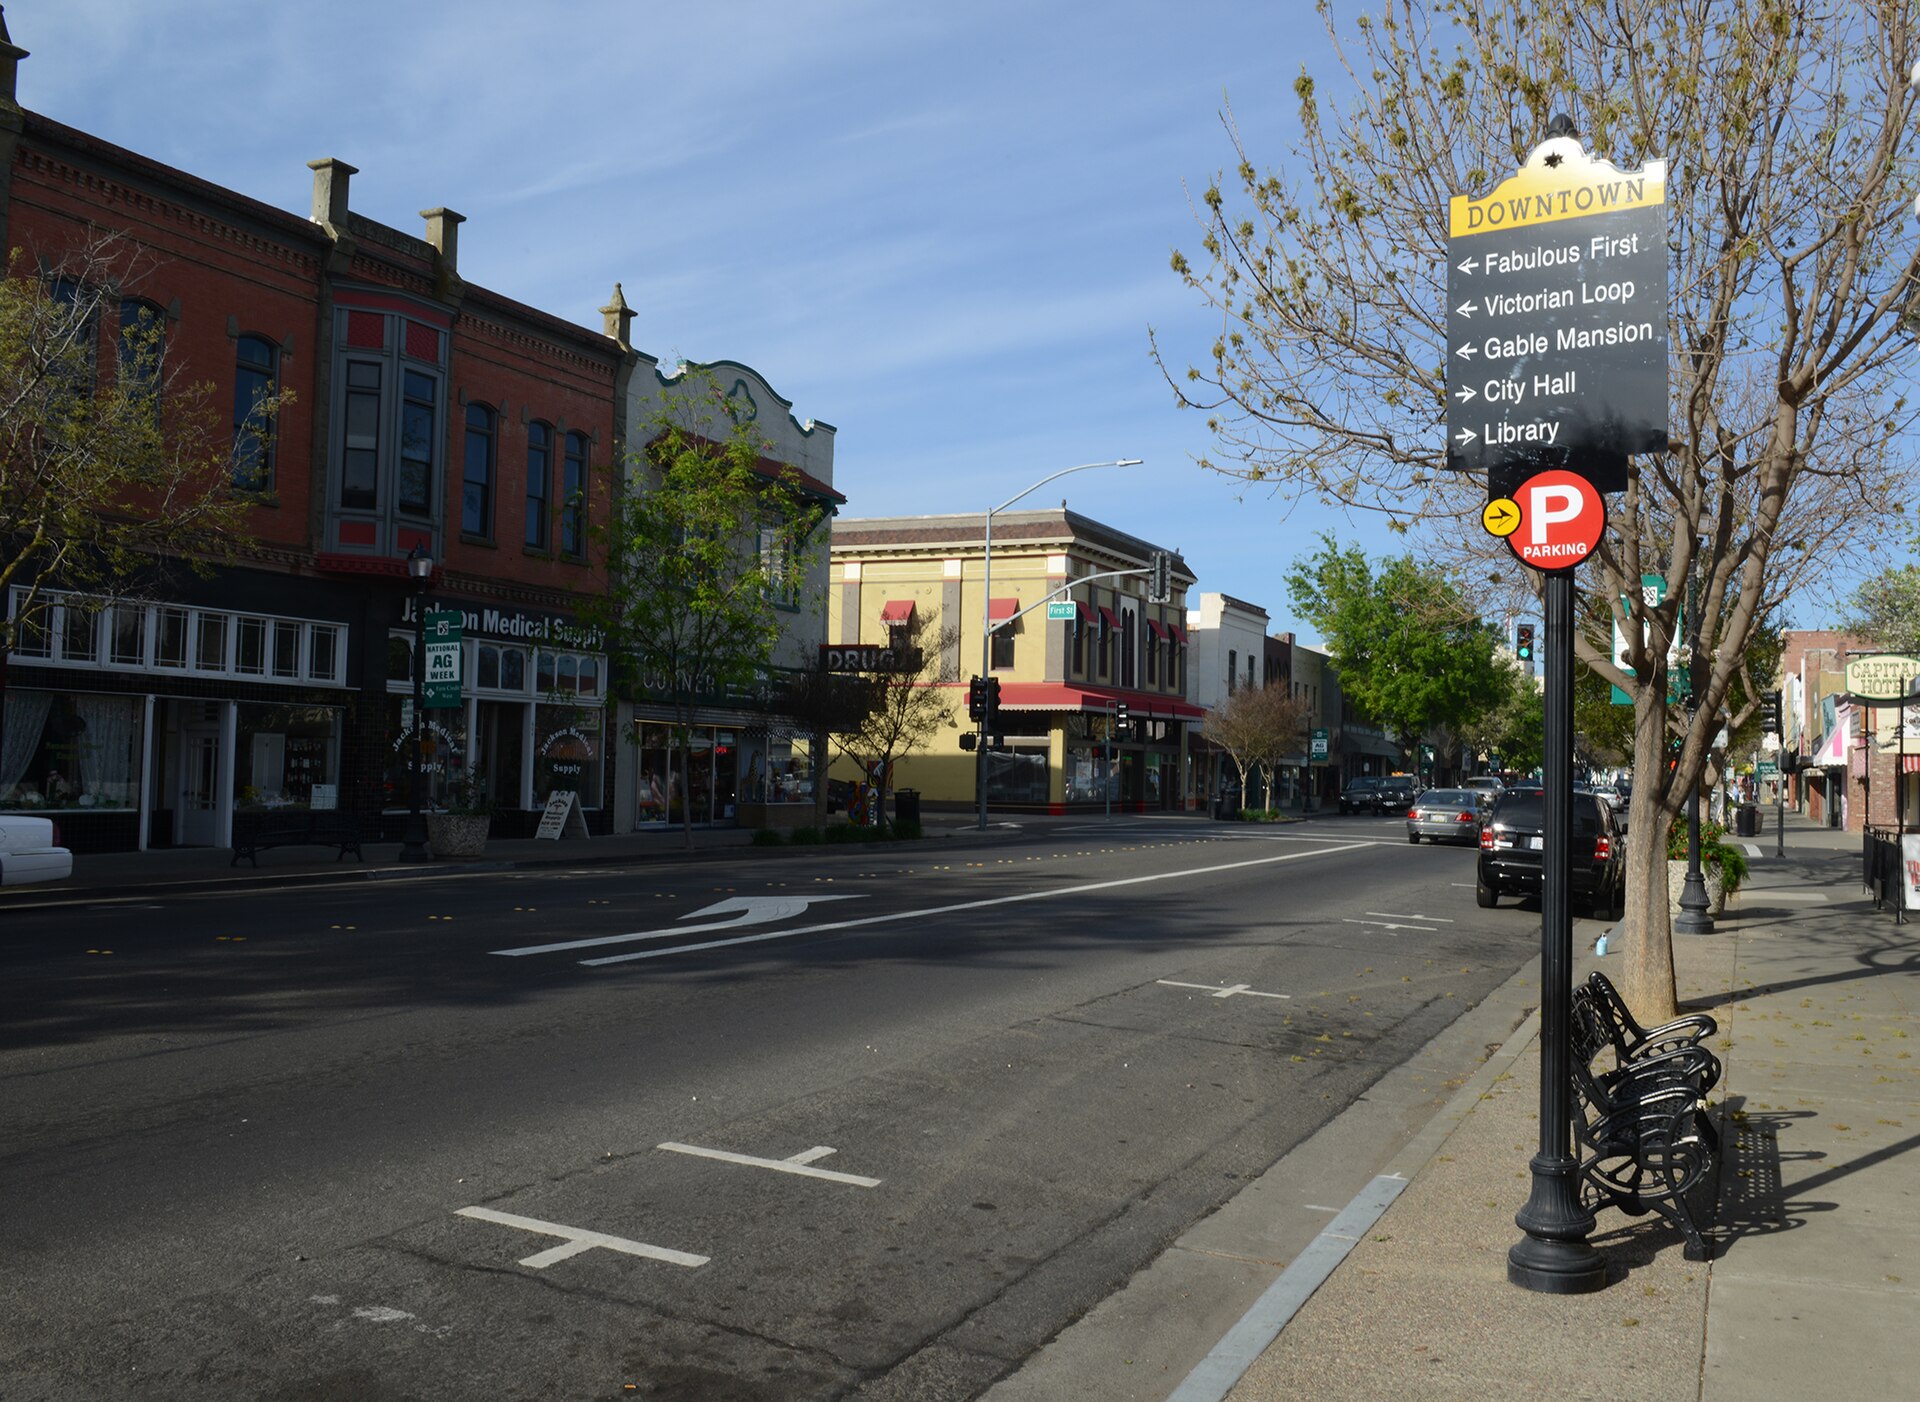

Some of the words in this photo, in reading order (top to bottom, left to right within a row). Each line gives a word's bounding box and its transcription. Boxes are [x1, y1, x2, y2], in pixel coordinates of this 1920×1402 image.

[1467, 178, 1645, 229] DOWNTOWN
[1485, 245, 1580, 275] Fabulous
[1591, 233, 1638, 259] First
[1484, 288, 1574, 317] Victorian
[1582, 280, 1635, 304] Loop
[1484, 333, 1549, 359] Gable
[1557, 321, 1652, 351] Mansion
[1484, 379, 1526, 404] City
[1534, 371, 1576, 396] Hall
[1484, 421, 1560, 445] Library
[1530, 484, 1584, 545] P
[1523, 543, 1587, 559] PARKING
[1050, 606, 1065, 615] First
[1066, 606, 1073, 615] St
[482, 608, 550, 639] Medical
[553, 617, 607, 650] Supply
[427, 645, 459, 653] NATIONAL
[432, 654, 453, 669] AG
[1851, 662, 1920, 679] CAPITAL
[430, 670, 455, 680] WEEK
[1861, 678, 1910, 695] HOTEL
[428, 720, 459, 753] Medical
[540, 728, 567, 756] Jackson
[568, 726, 593, 756] Medical
[407, 760, 443, 774] Spply
[553, 763, 581, 775] Supply
